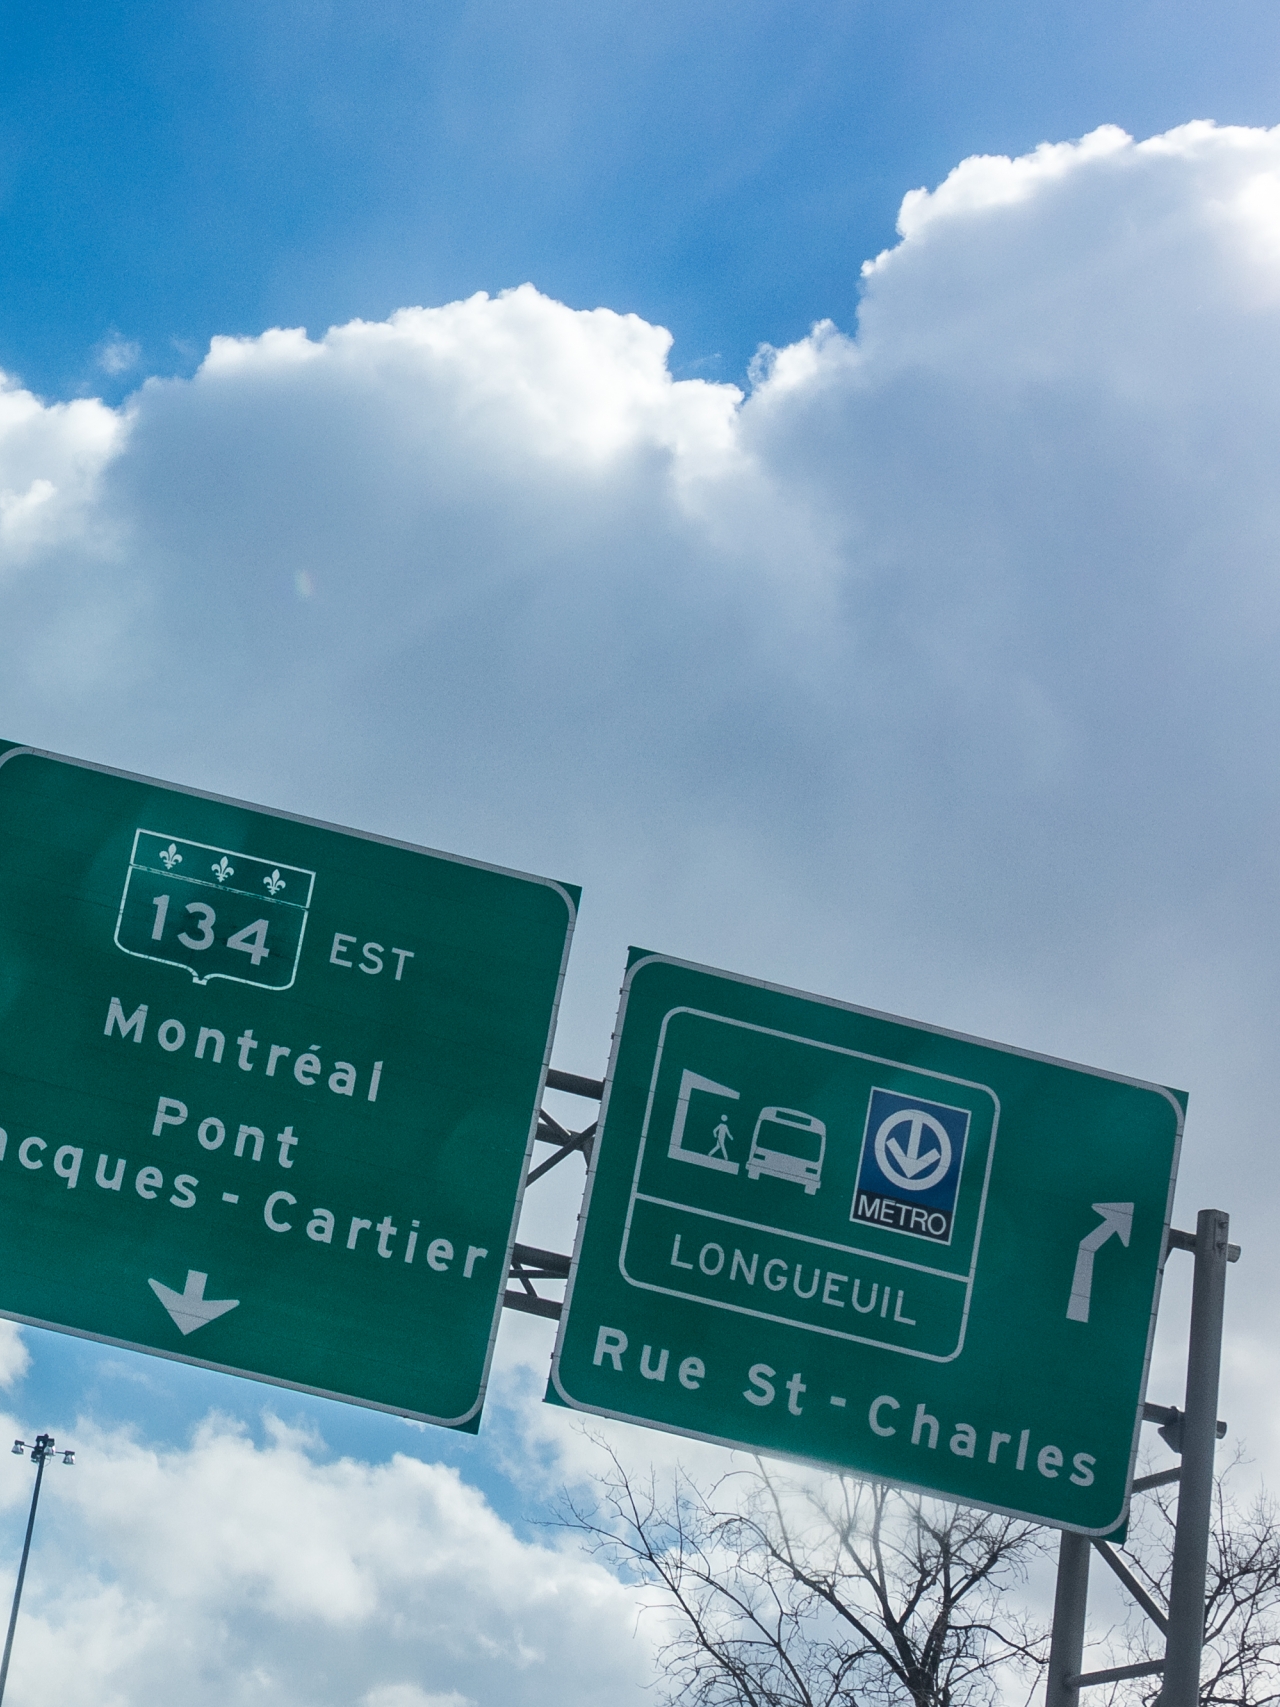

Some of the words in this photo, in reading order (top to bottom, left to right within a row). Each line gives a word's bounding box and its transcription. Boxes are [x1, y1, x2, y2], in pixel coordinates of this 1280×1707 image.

[151, 895, 270, 965] 134
[329, 933, 415, 981] EST
[103, 997, 384, 1102] Montréal
[152, 1097, 299, 1169] Pont
[670, 1235, 917, 1325] LONGUEUIL
[592, 1325, 706, 1389] Rue
